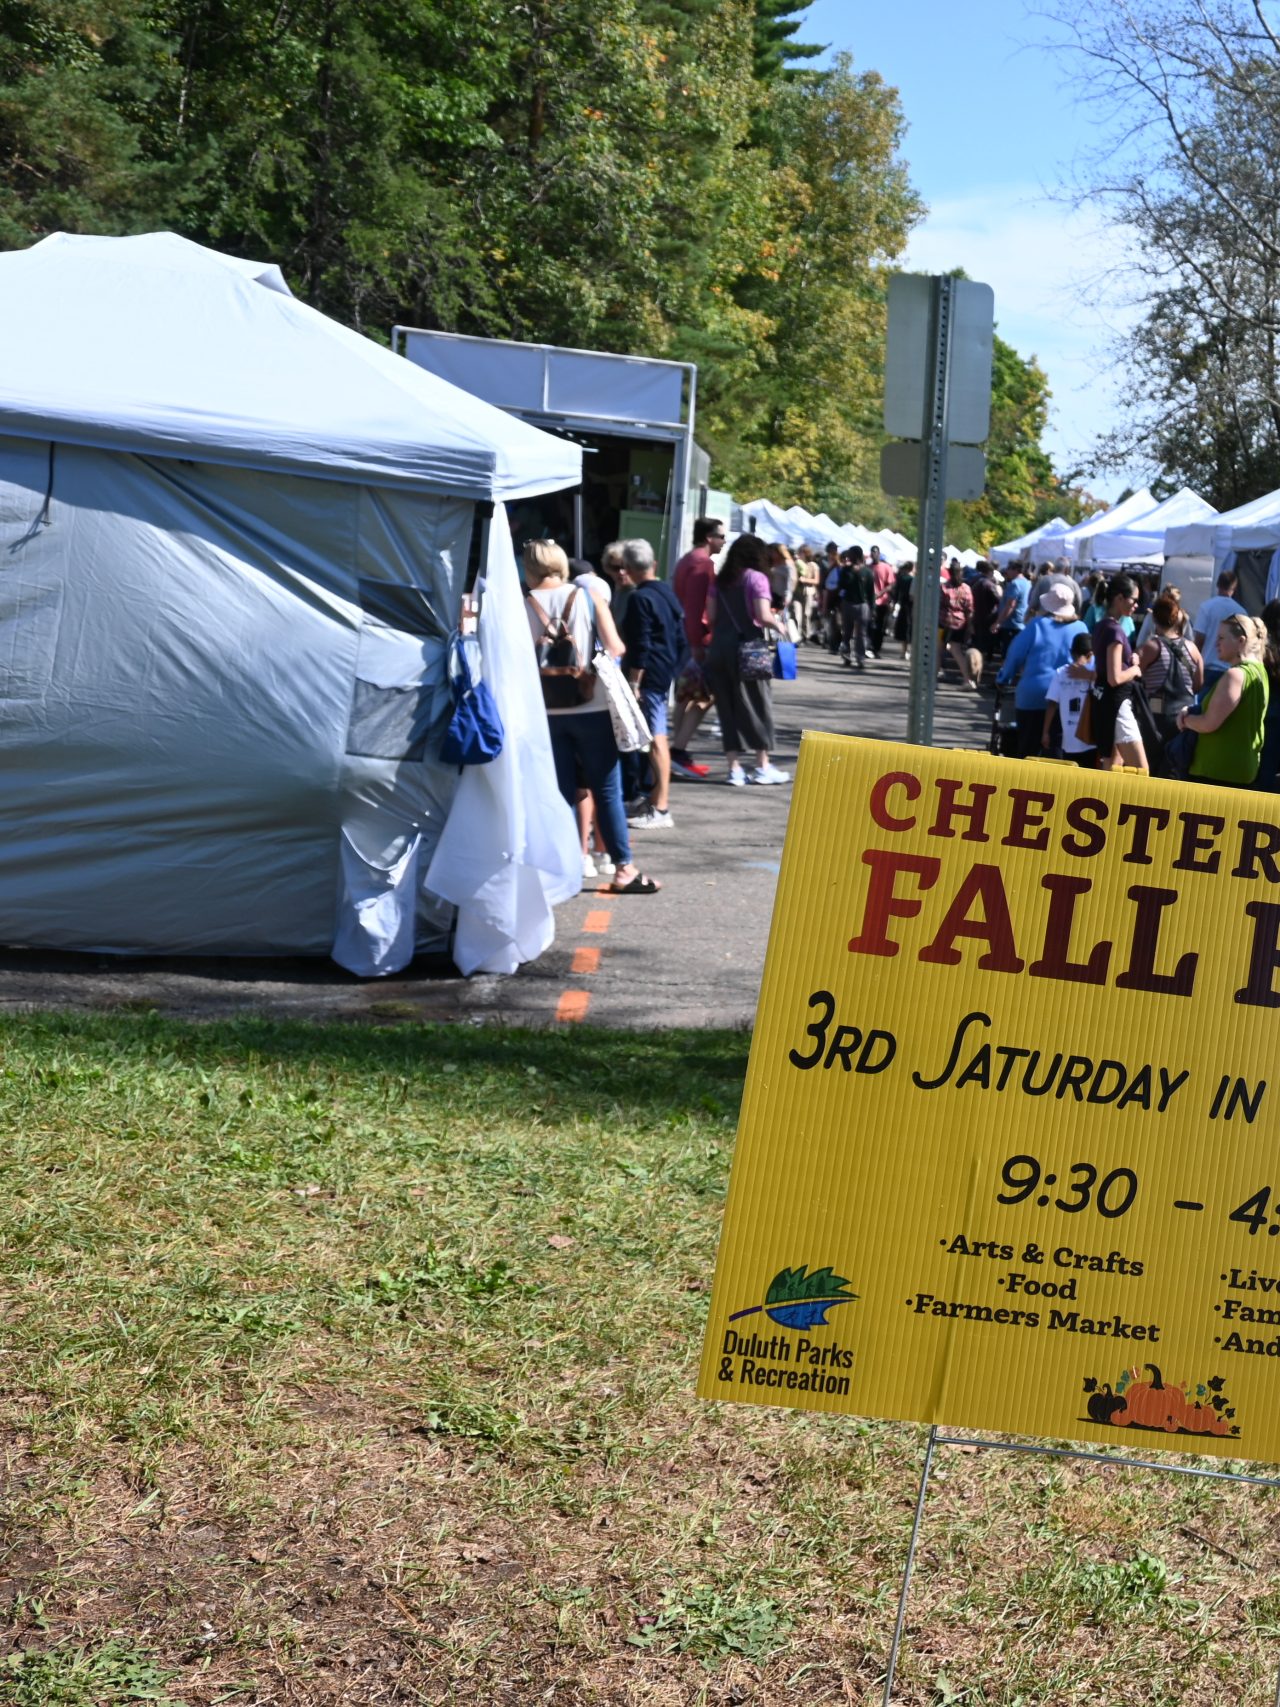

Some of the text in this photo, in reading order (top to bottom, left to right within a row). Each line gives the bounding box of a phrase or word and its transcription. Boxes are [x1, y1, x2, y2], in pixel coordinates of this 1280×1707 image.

[847, 848, 1199, 998] FALL
[789, 990, 897, 1075] 3RD
[912, 1011, 1190, 1113] SATURDAY
[1209, 1075, 1267, 1124] IN
[996, 1154, 1138, 1219] 9:30
[1021, 1243, 1045, 1265] &
[1053, 1247, 1144, 1277] Crafts
[1047, 1309, 1161, 1342] Market
[722, 1330, 854, 1368] Duluth Parks
[718, 1356, 851, 1396] & Recreation
